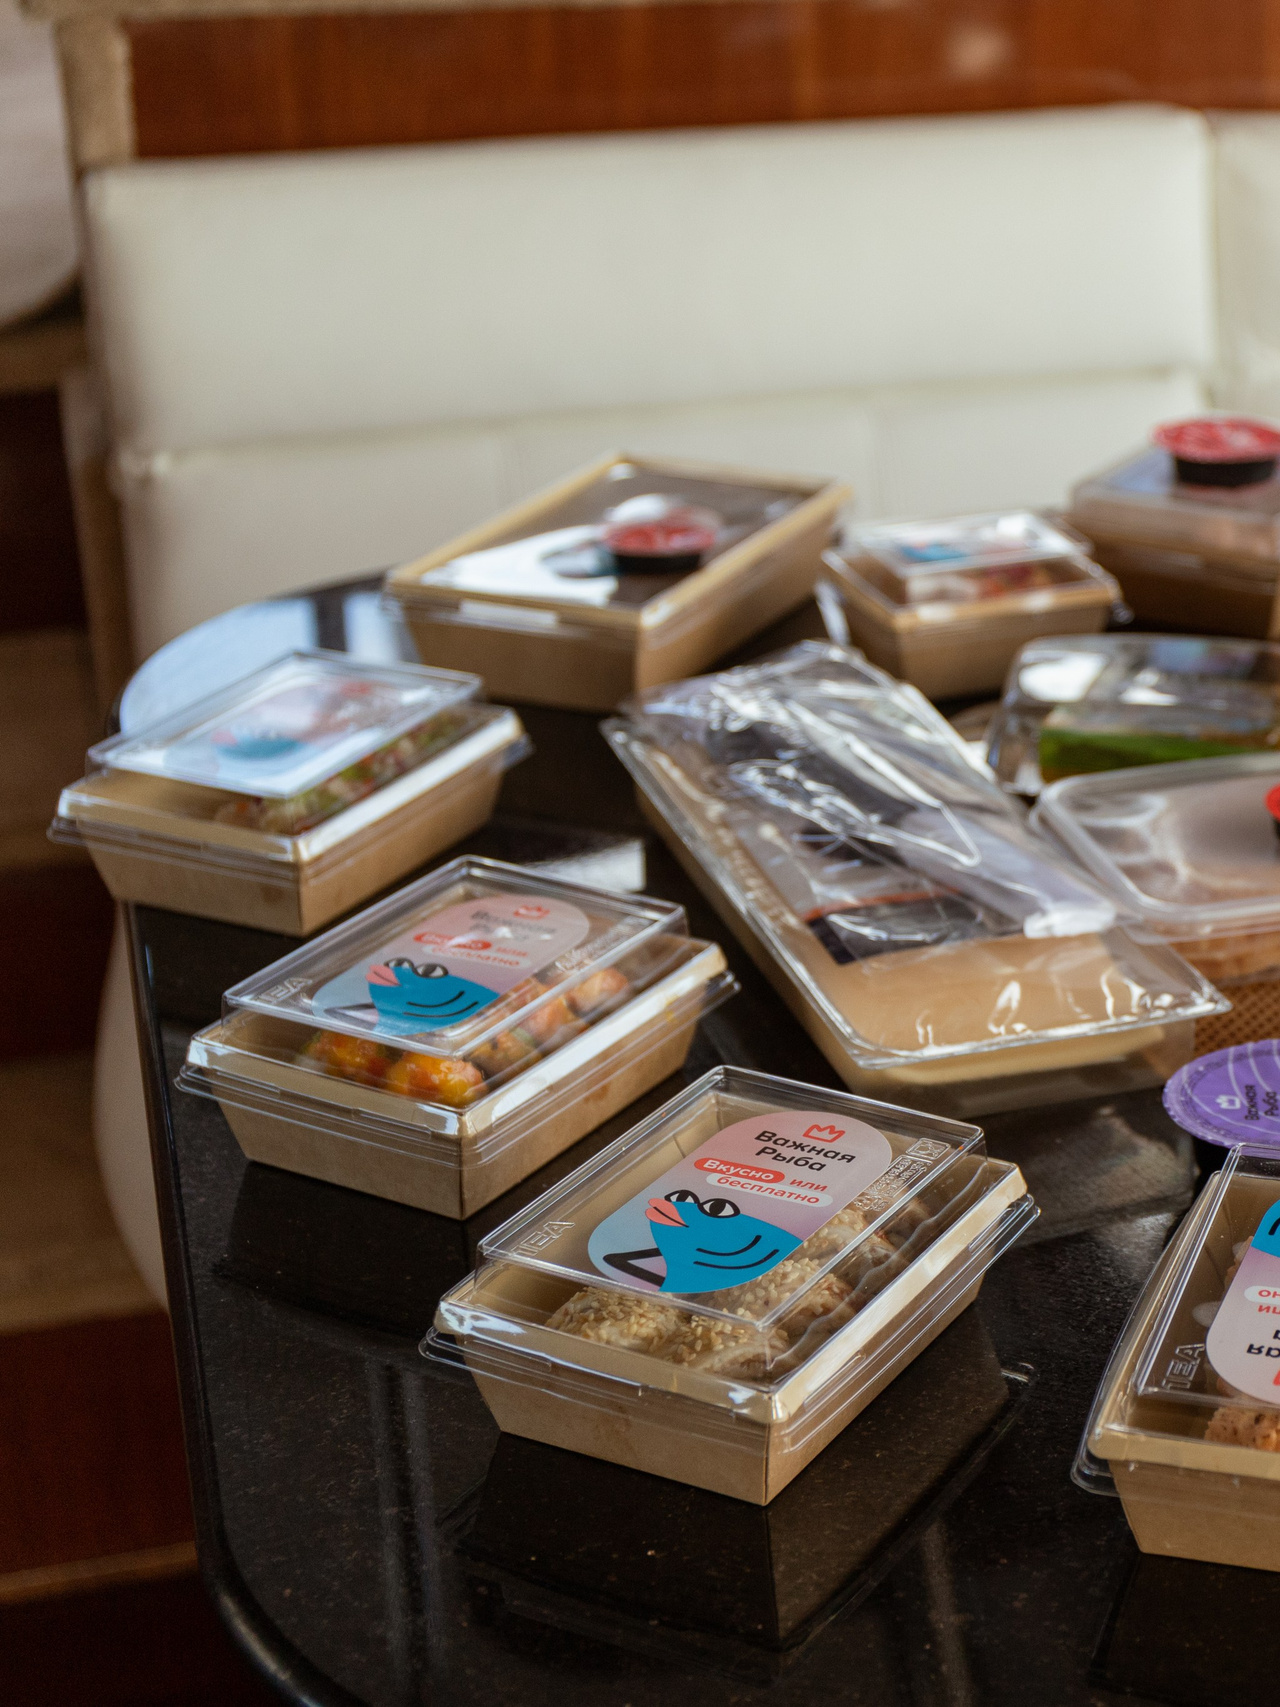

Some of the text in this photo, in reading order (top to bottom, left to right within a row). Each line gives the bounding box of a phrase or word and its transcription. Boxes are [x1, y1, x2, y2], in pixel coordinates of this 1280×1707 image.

[1244, 1084, 1260, 1121] Важная
[1263, 1091, 1279, 1117] Рыба
[754, 1130, 856, 1164] Важная
[755, 1146, 827, 1172] Рыба
[703, 1159, 828, 1192] Вкусно или
[717, 1176, 820, 1205] бесплатно
